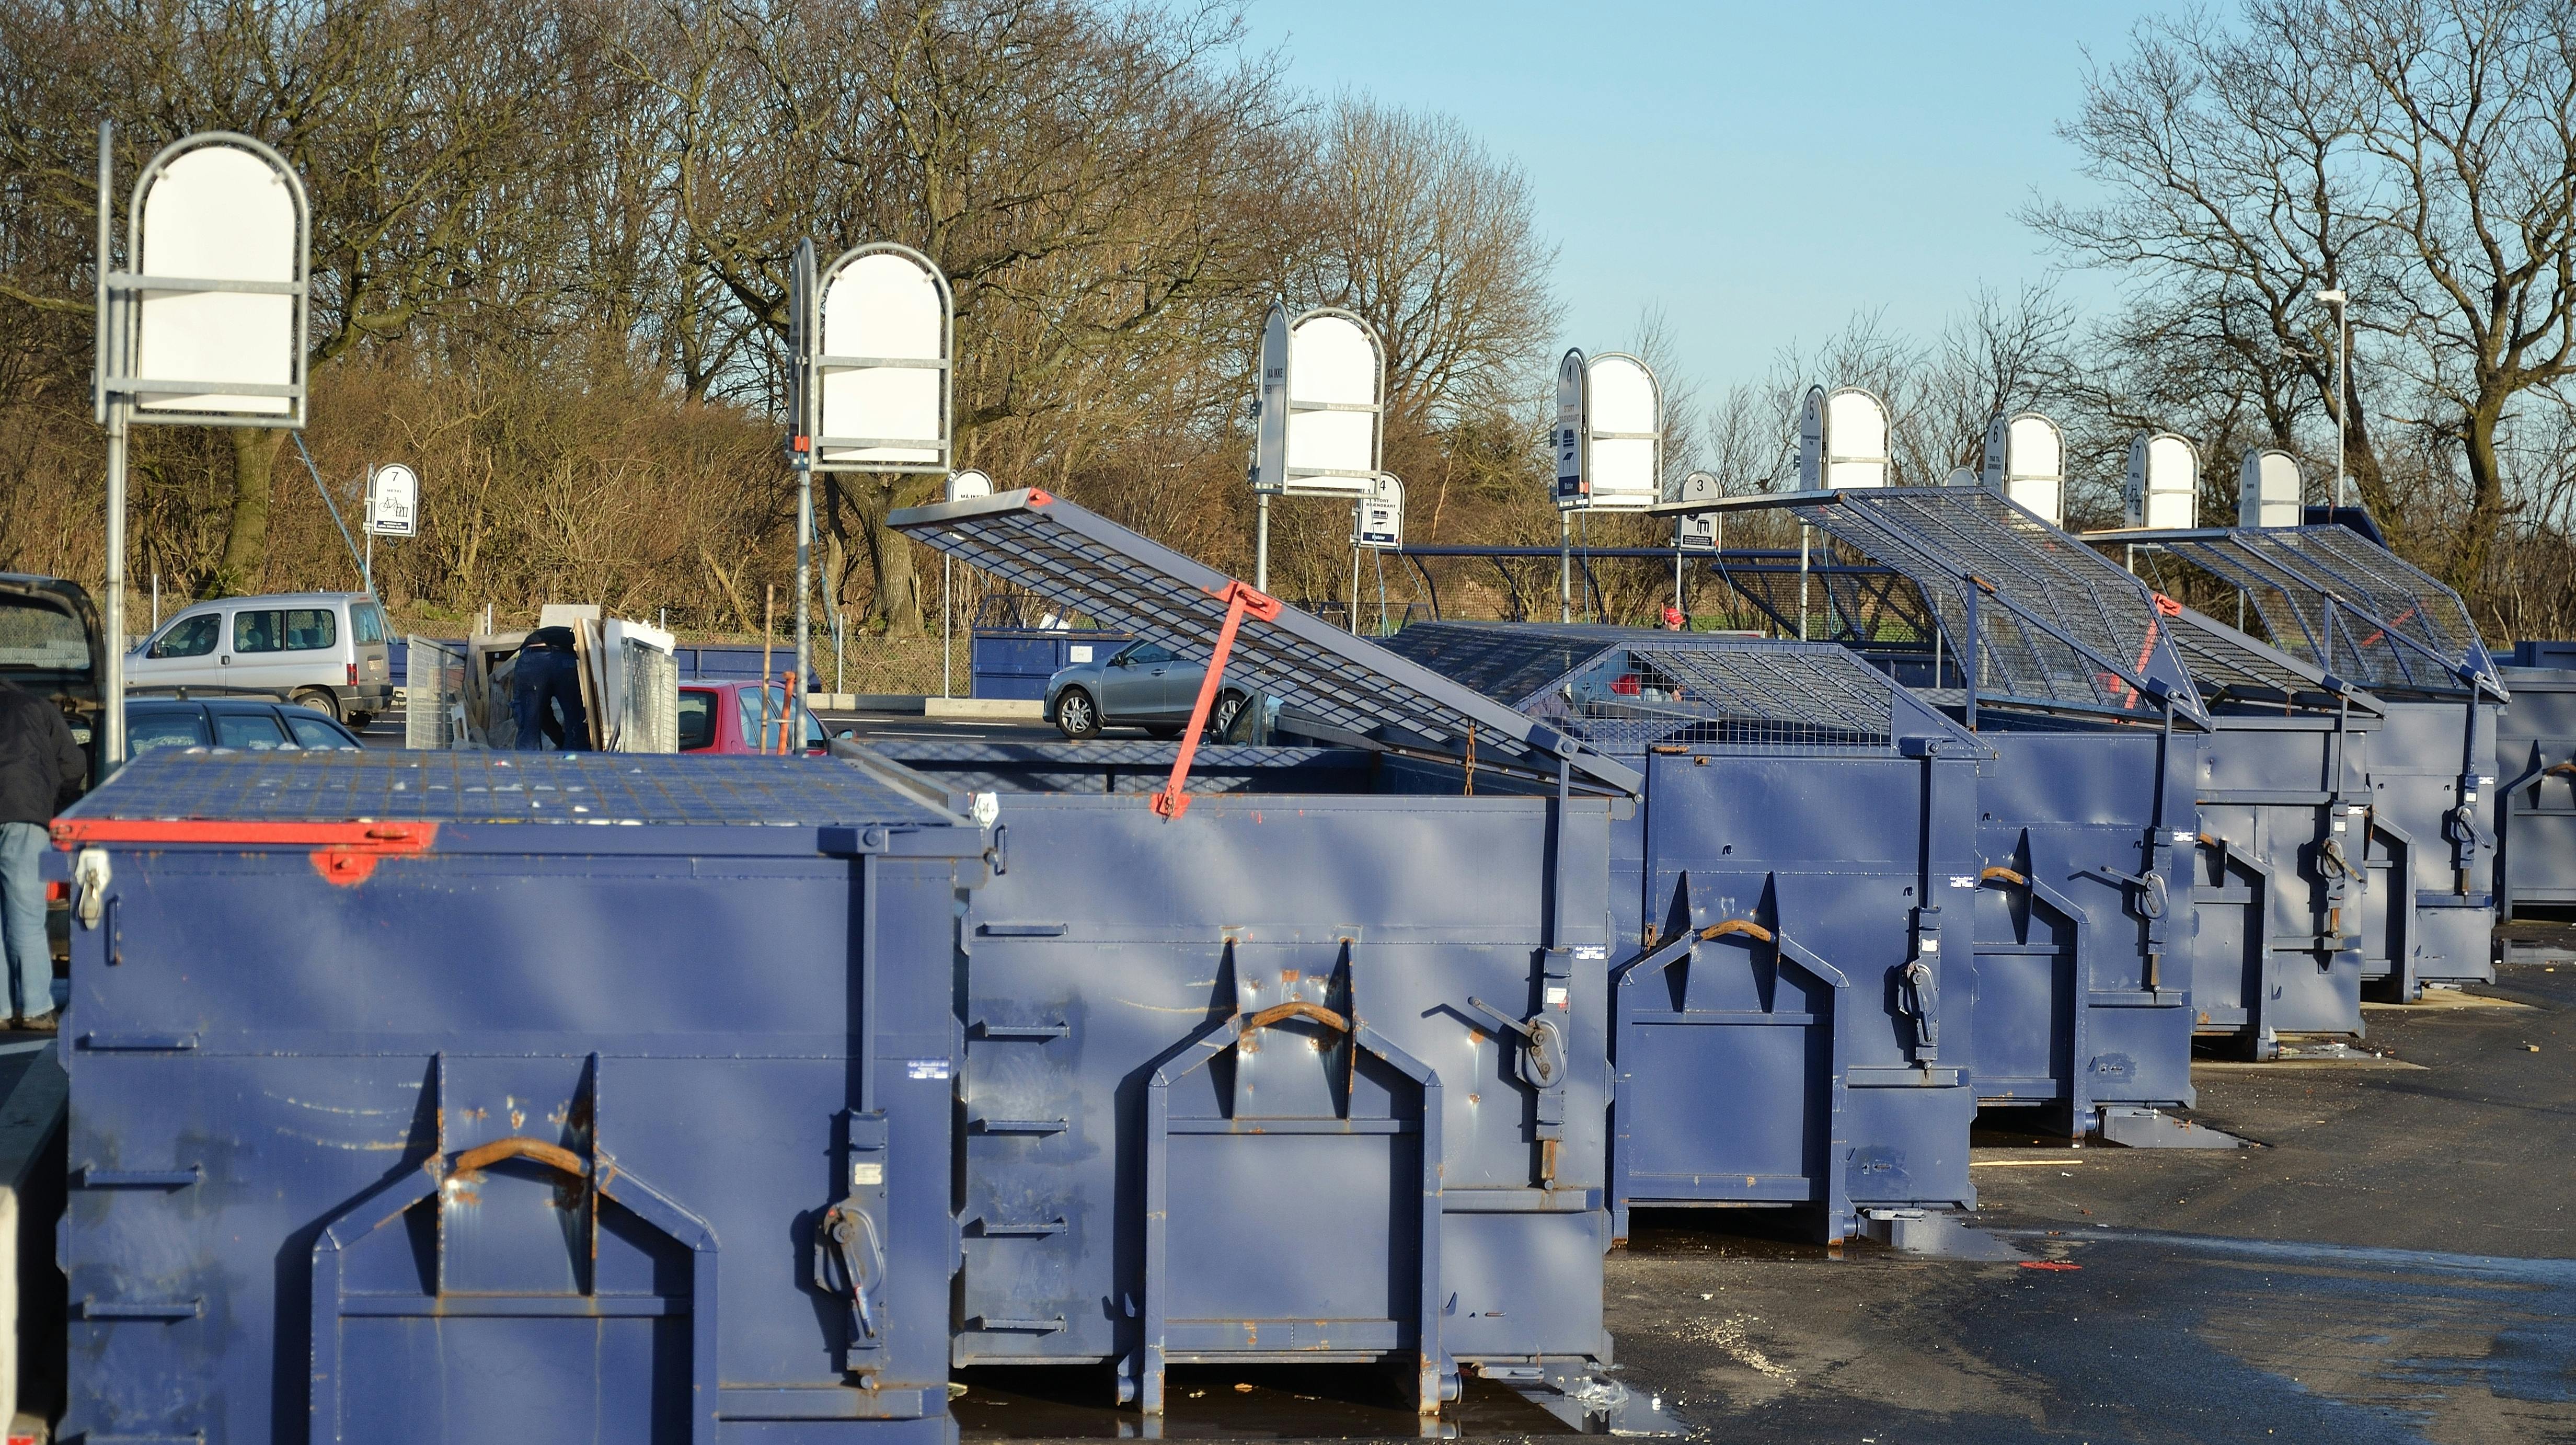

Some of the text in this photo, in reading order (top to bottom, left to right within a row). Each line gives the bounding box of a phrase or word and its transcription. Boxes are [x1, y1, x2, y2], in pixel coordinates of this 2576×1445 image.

[1267, 365, 1283, 379] MÅ IKKE
[1567, 365, 1572, 387] 4
[1809, 400, 1814, 420] 5
[1993, 425, 1998, 443] 6
[2135, 445, 2140, 461] 7
[2249, 459, 2252, 474] 1
[392, 472, 399, 481] 7
[1380, 480, 1386, 491] 4
[1697, 479, 1704, 491] 3
